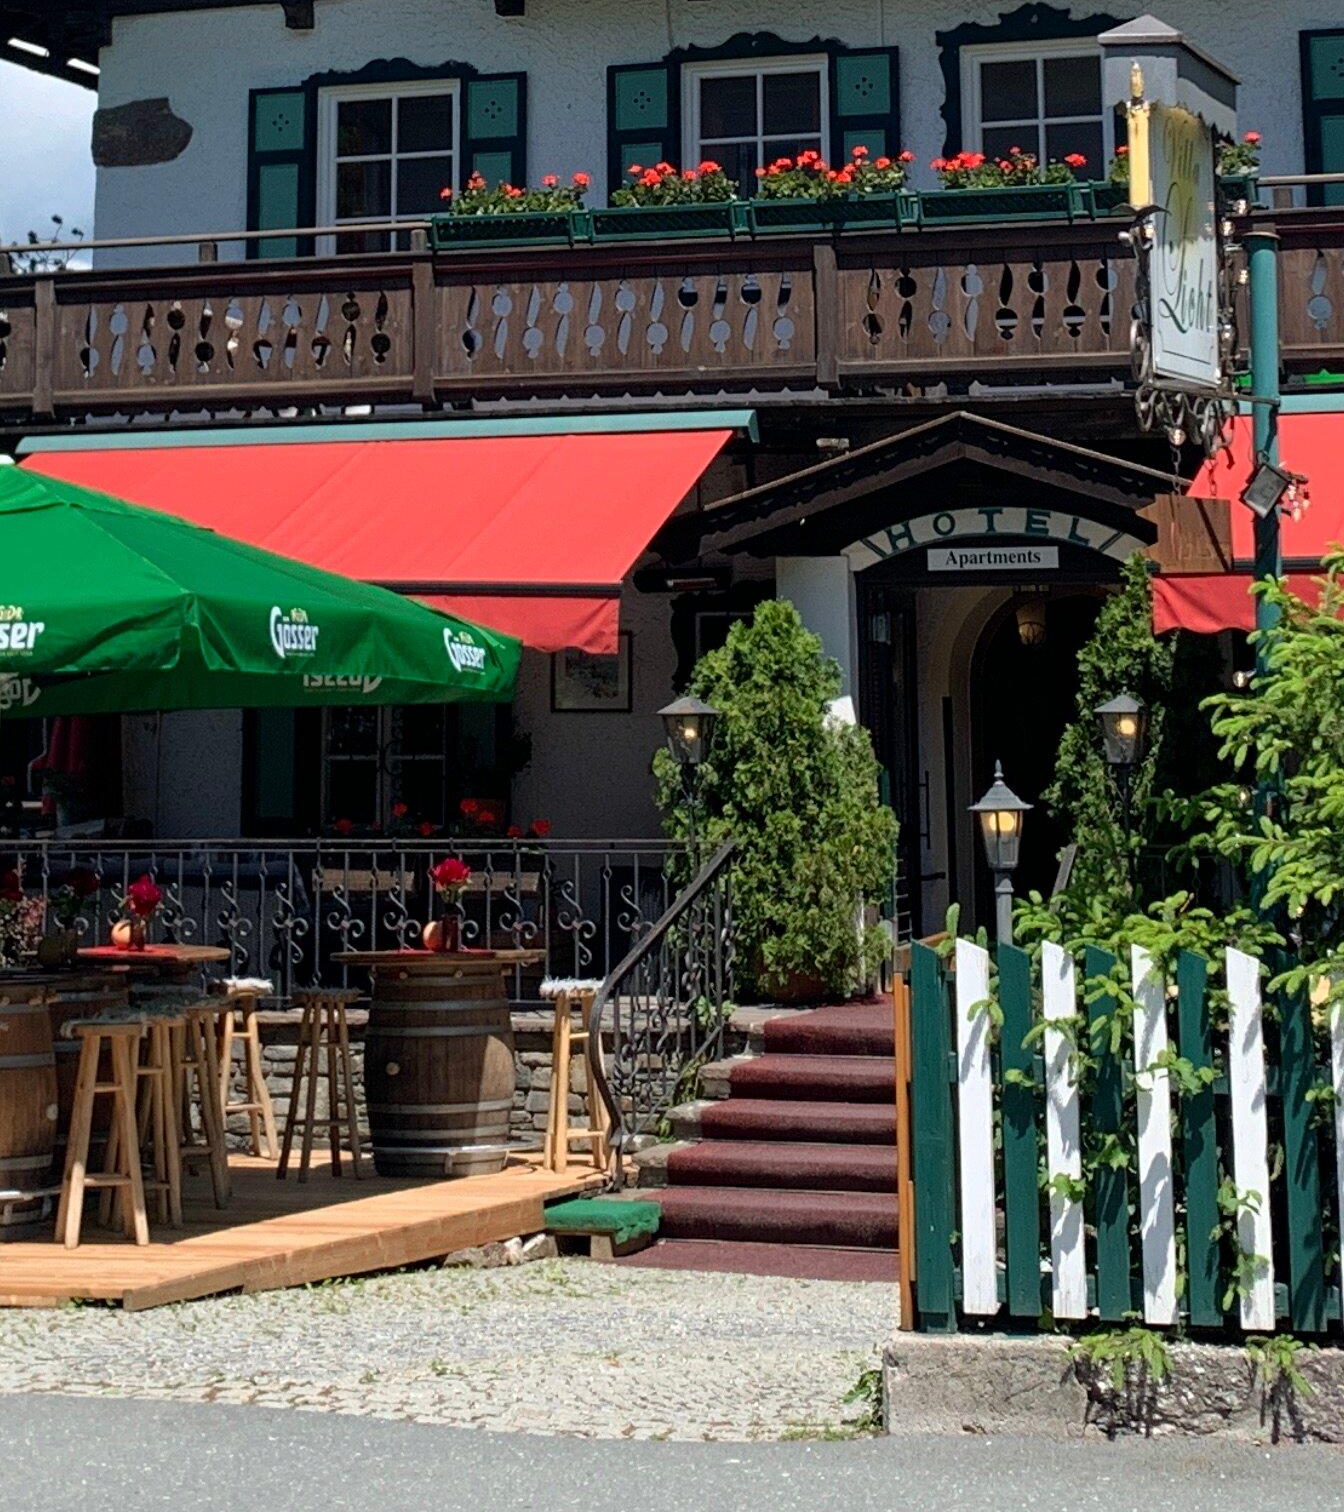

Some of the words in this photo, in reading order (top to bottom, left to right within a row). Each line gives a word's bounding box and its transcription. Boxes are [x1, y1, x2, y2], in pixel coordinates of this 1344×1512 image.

[1157, 182, 1213, 334] Licht
[884, 507, 1090, 553] HOTEL
[945, 550, 1041, 567] Apartments
[269, 606, 319, 659] Gösser
[443, 627, 486, 672] Gösser
